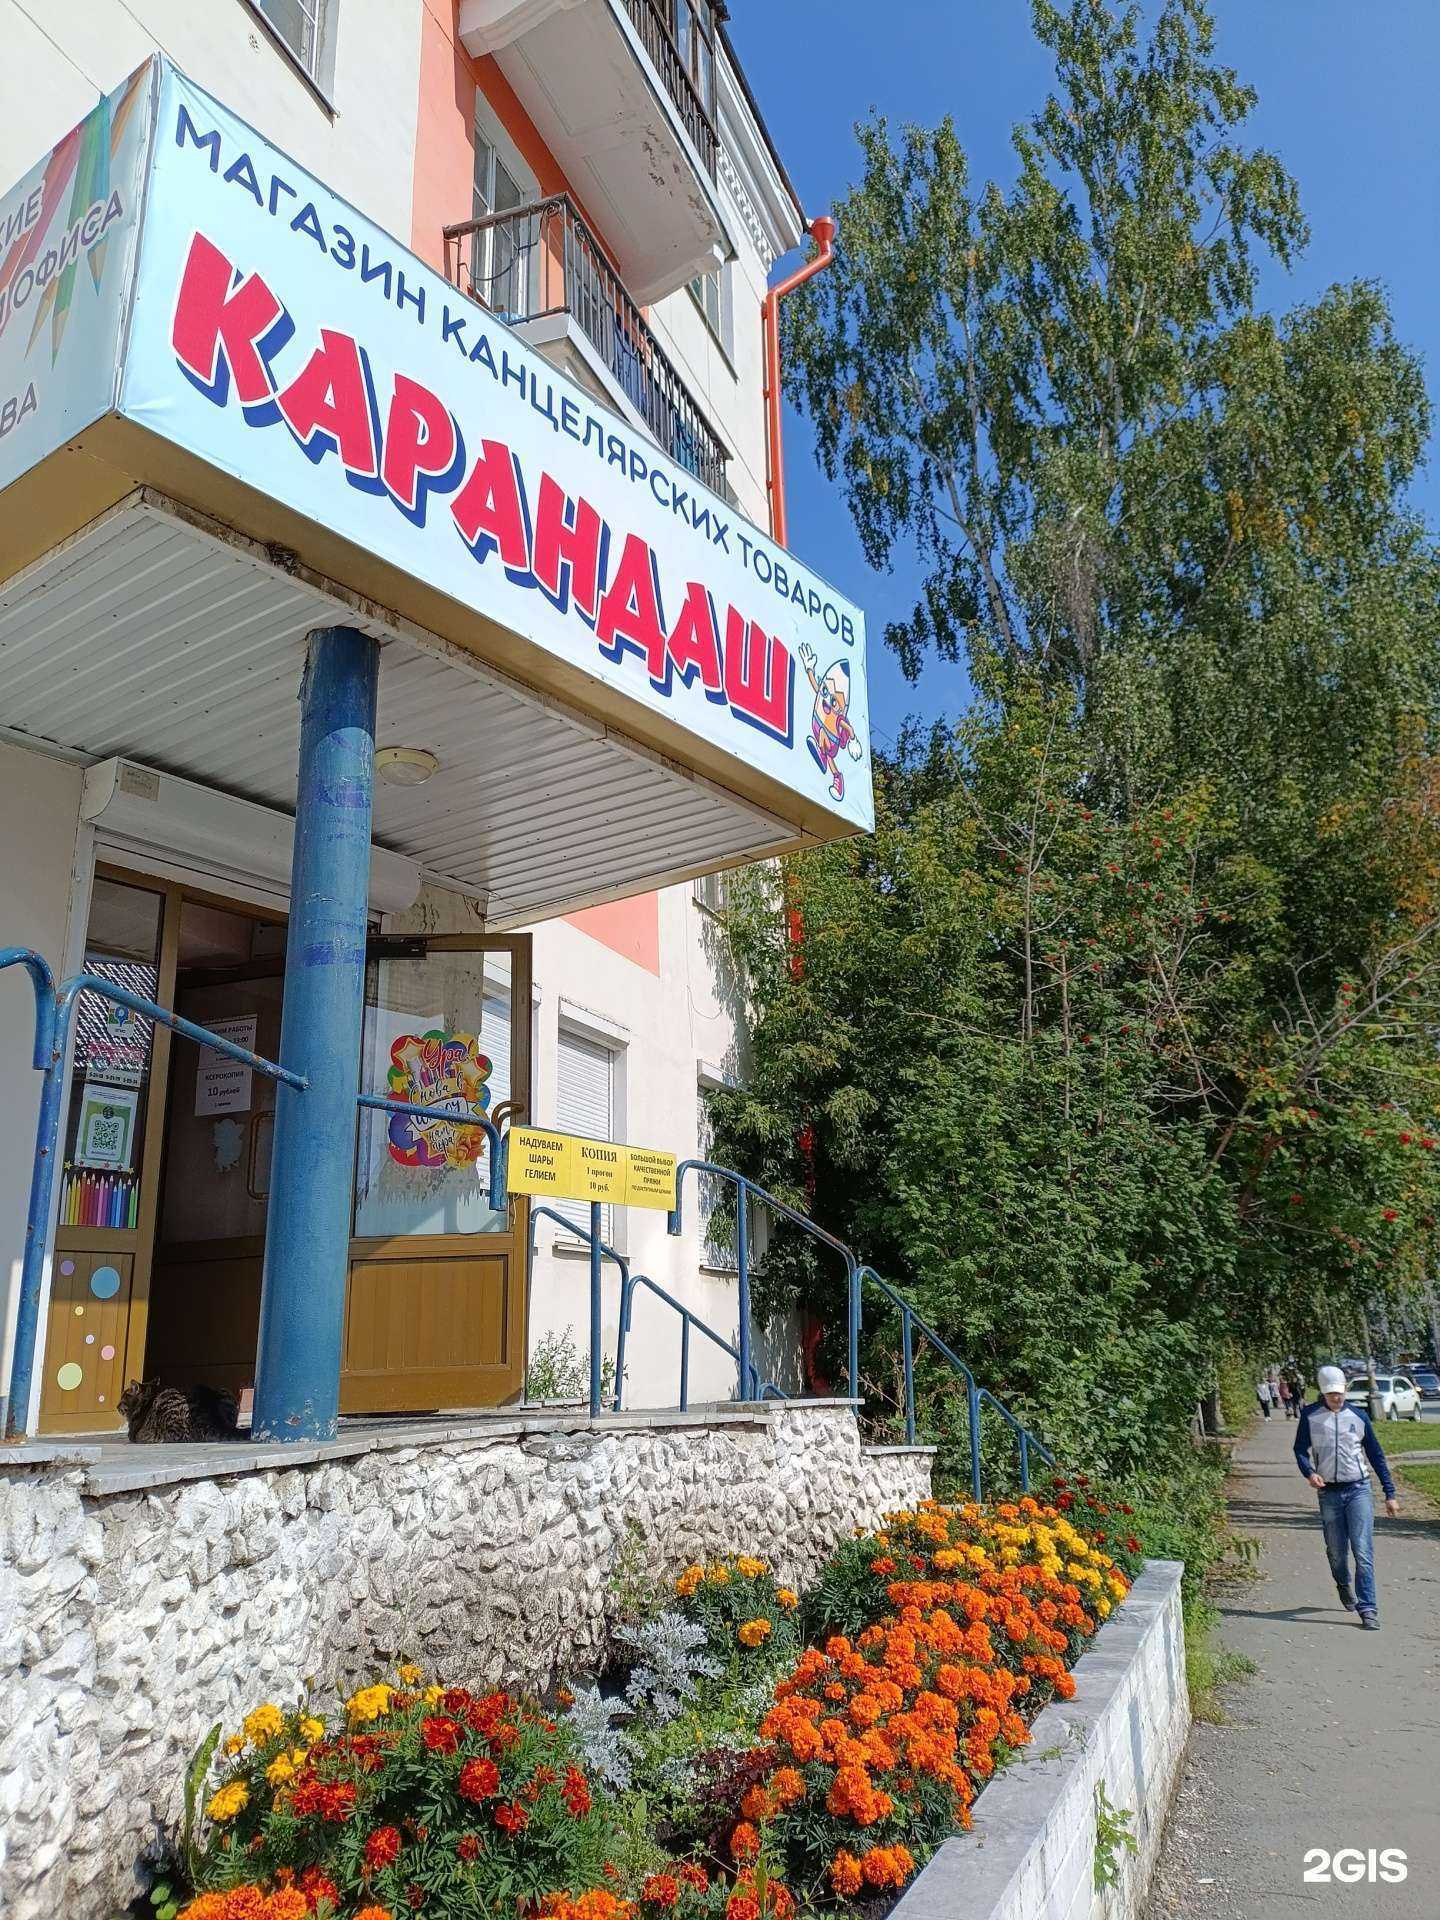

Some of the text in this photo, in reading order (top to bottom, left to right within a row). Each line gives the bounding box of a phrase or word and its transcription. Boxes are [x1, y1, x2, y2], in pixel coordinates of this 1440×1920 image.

[13, 190, 124, 310] ОФИСА
[175, 103, 855, 647] МАГАЗИН КАНЦЕЛЯРСКИХ ТОВАРОВ
[171, 230, 794, 750] КАРАНДАШ
[422, 1039, 475, 1080] Ура!
[205, 1070, 244, 1081] КСЕРОКОПИЯ
[207, 1086, 241, 1097] 10 рублей
[519, 1136, 563, 1152] НАДУВАЕМ
[529, 1153, 553, 1166] ШАРЫ
[581, 1146, 617, 1163] КОПИЯ
[630, 1153, 674, 1167] БОЛЬШОЙ ВЫБОР
[525, 1168, 556, 1181] ГЕЛИЕМ
[633, 1164, 671, 1177] КАЧЕСТВЕННОЙ
[589, 1182, 610, 1193] 10 руб.
